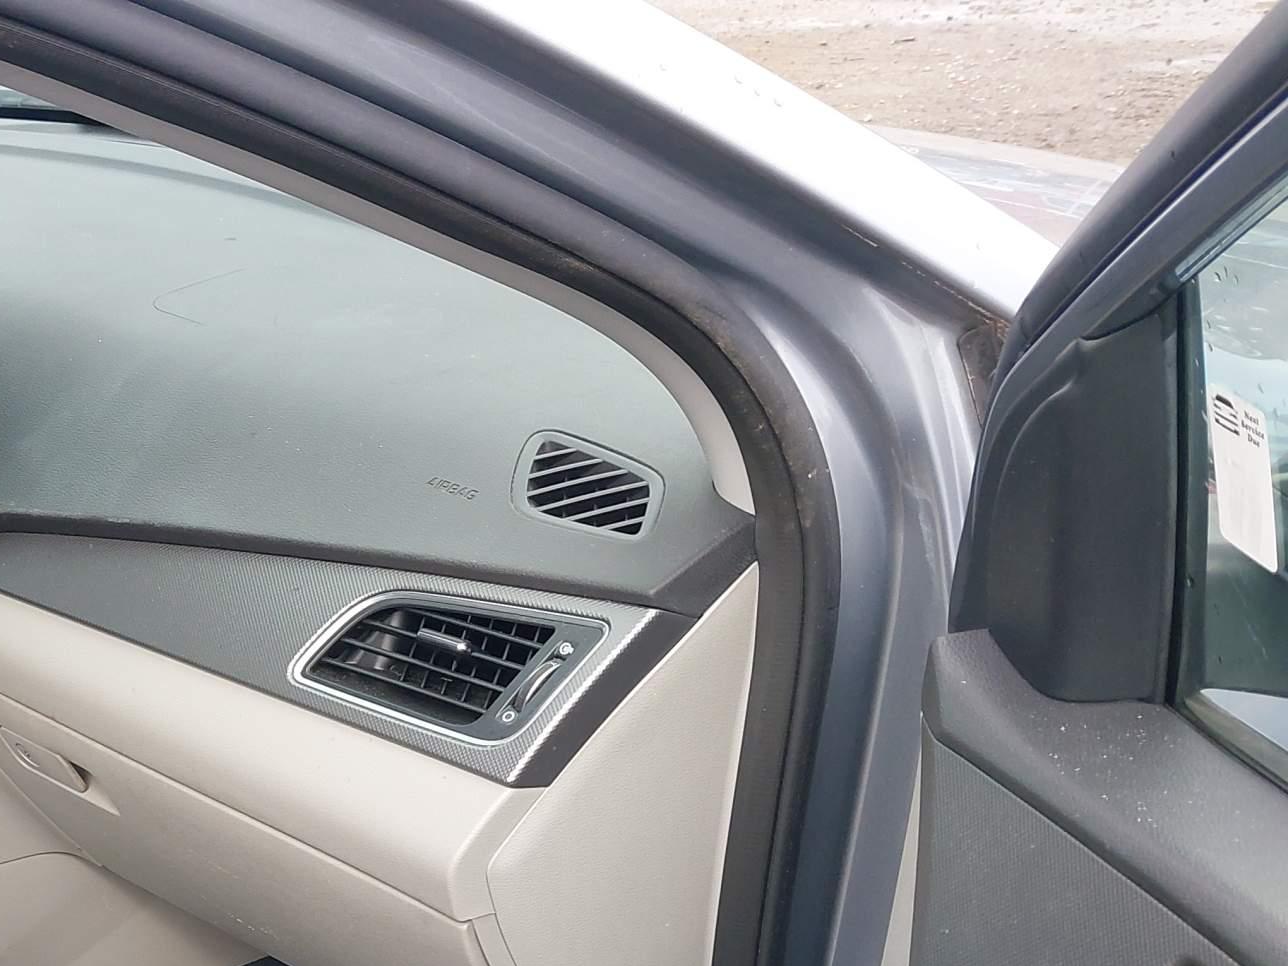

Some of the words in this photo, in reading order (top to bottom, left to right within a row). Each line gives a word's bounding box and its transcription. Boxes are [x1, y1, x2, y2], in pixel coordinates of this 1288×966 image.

[1244, 410, 1260, 426] Next
[1241, 419, 1264, 439] Service
[1247, 433, 1260, 447] Due
[426, 477, 480, 500] AIRBAG
